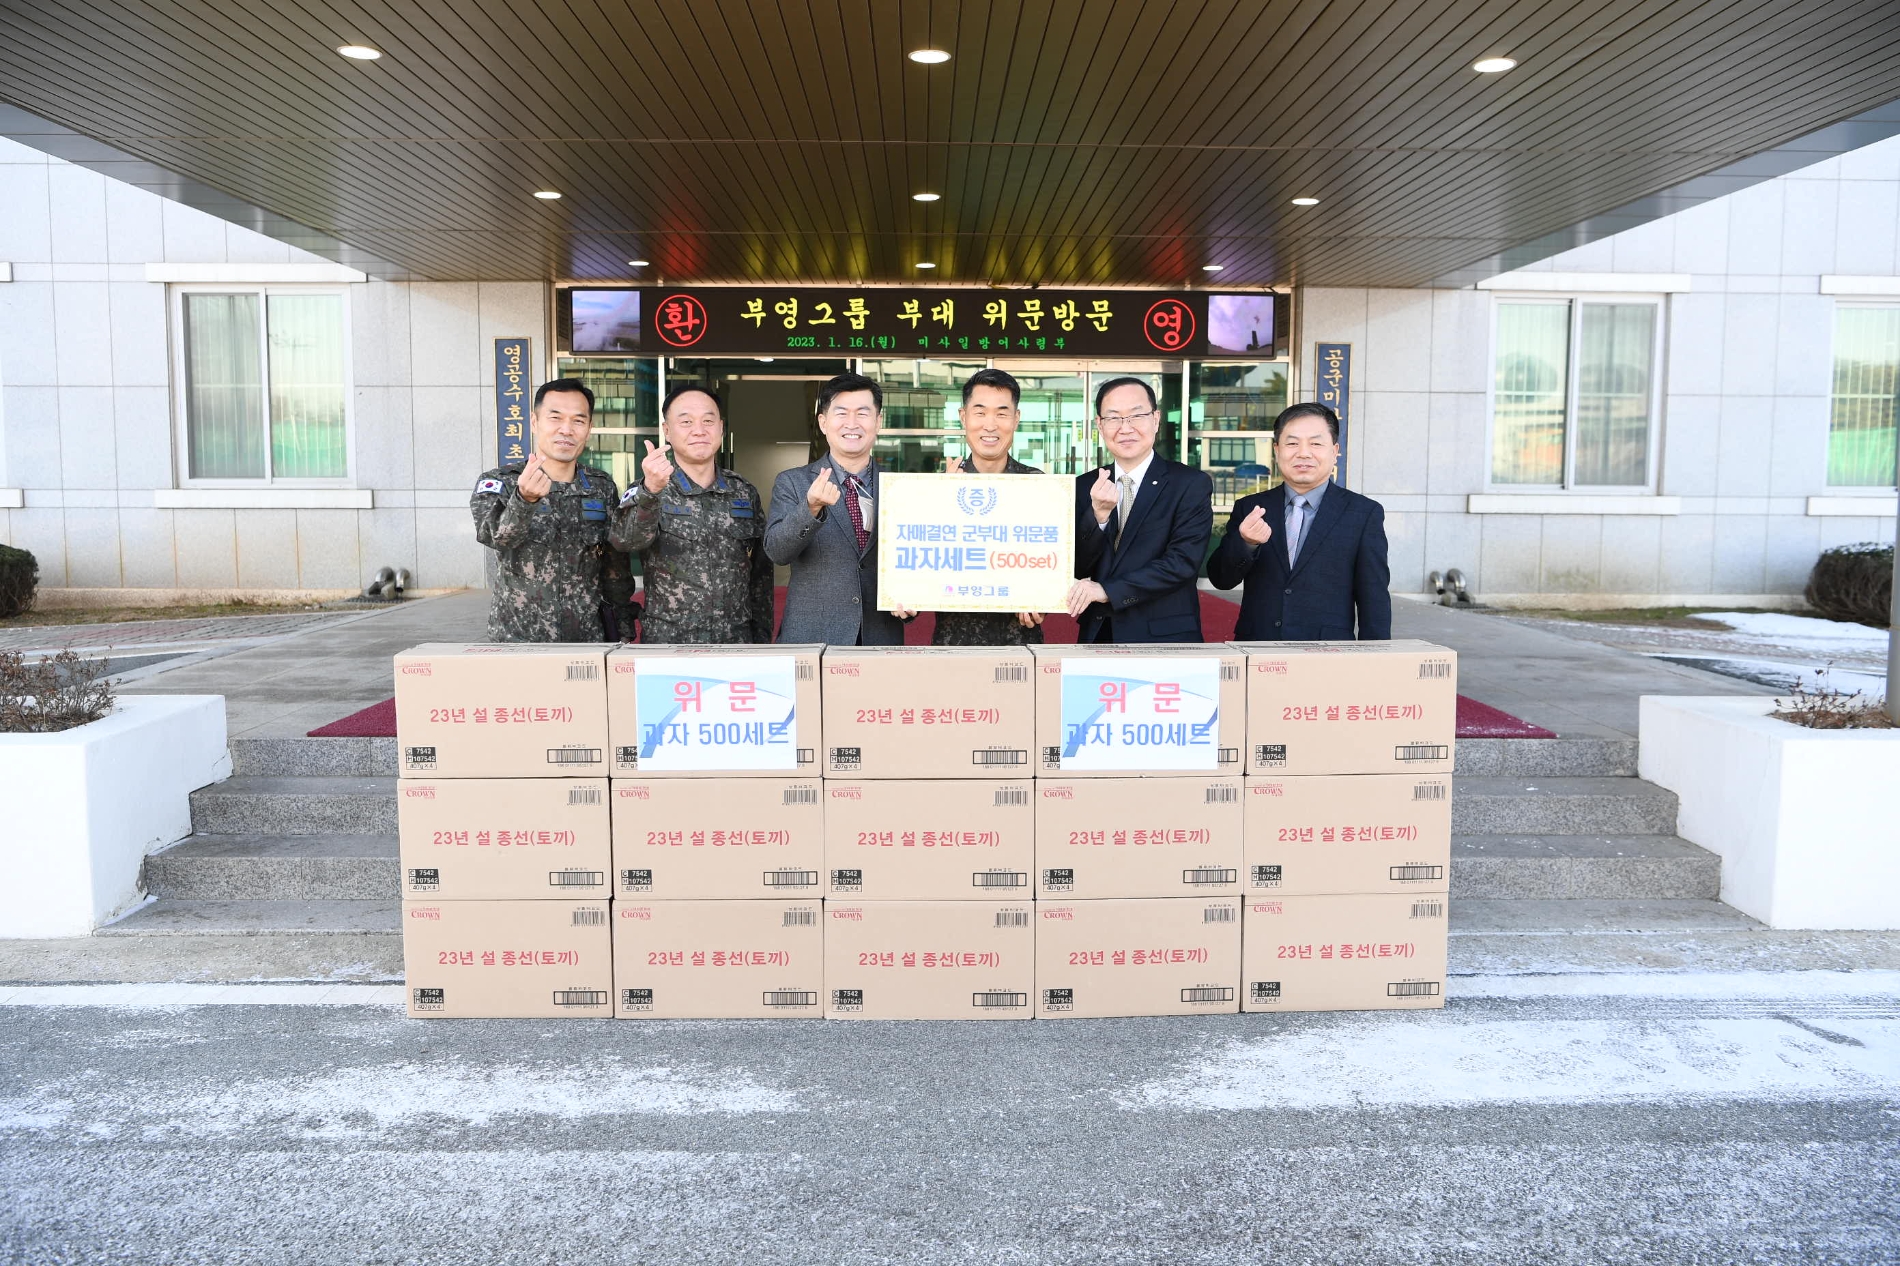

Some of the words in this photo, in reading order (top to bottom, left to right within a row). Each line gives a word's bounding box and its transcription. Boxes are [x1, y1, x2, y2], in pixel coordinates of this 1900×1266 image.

[663, 301, 700, 341] 환
[740, 297, 870, 330] 부영그룹
[897, 298, 954, 330] 부대
[982, 299, 1113, 332] 위문방문
[1153, 306, 1182, 346] 영
[787, 337, 820, 348] 2023.
[828, 337, 841, 348] 1.
[969, 488, 985, 507] 증
[896, 524, 957, 542] 자매결연
[962, 524, 1008, 543] 군부대
[1012, 525, 1059, 543] 위문품
[402, 666, 431, 675] CROWN
[615, 666, 635, 674] CRO
[830, 667, 859, 675] CROWN
[1258, 665, 1287, 673] CROWN
[430, 708, 466, 723] 23년
[473, 707, 489, 724] 설
[494, 707, 573, 724] 종선(토끼)
[856, 709, 894, 724] 23년
[899, 709, 916, 725] 설
[921, 708, 1001, 725] 종선(토끼)
[1282, 706, 1319, 721] 23년
[1325, 706, 1341, 721] 설
[1345, 705, 1423, 721] 종선(토끼)
[643, 722, 689, 746] 과자
[699, 722, 789, 745] 500세트
[1066, 723, 1113, 746] 과자
[1122, 723, 1211, 746] 500세트
[620, 790, 650, 798] CROWN
[832, 790, 861, 798] CROWN
[1254, 787, 1282, 795] CROWN
[433, 830, 469, 846] 23년
[476, 832, 491, 846] 설
[497, 830, 576, 846] 종선(토끼)
[646, 831, 684, 846] 23년
[689, 831, 706, 846] 설
[711, 830, 790, 846] 종선(토끼)
[857, 832, 894, 847] 23년
[901, 832, 916, 847] 설
[922, 831, 1001, 847] 종선(토끼)
[1069, 831, 1106, 846] 23년
[1113, 830, 1128, 846] 설
[1132, 830, 1211, 845] 종선(토끼)
[1278, 827, 1314, 843] 23년
[1321, 826, 1336, 843] 설
[1342, 826, 1419, 842] 종선(토끼)
[411, 911, 440, 919] CROWN
[621, 910, 651, 918] CROWN
[833, 911, 862, 919] CROWN
[1253, 905, 1282, 913] CROWN
[438, 951, 475, 966] 23년
[480, 951, 496, 966] 설
[501, 950, 579, 966] 종선(토끼)
[648, 951, 684, 966] 23년
[690, 951, 706, 966] 설
[711, 951, 791, 966] 종선(토끼)
[858, 952, 896, 967] 23년
[901, 952, 917, 968] 설
[922, 952, 1000, 968] 종선(토끼)
[1069, 951, 1105, 966] 23년
[1111, 950, 1127, 965] 설
[1132, 948, 1208, 965] 종선(토끼)
[1277, 945, 1313, 960] 23년
[1320, 944, 1334, 959] 설
[1340, 944, 1415, 959] 종선(토끼)
